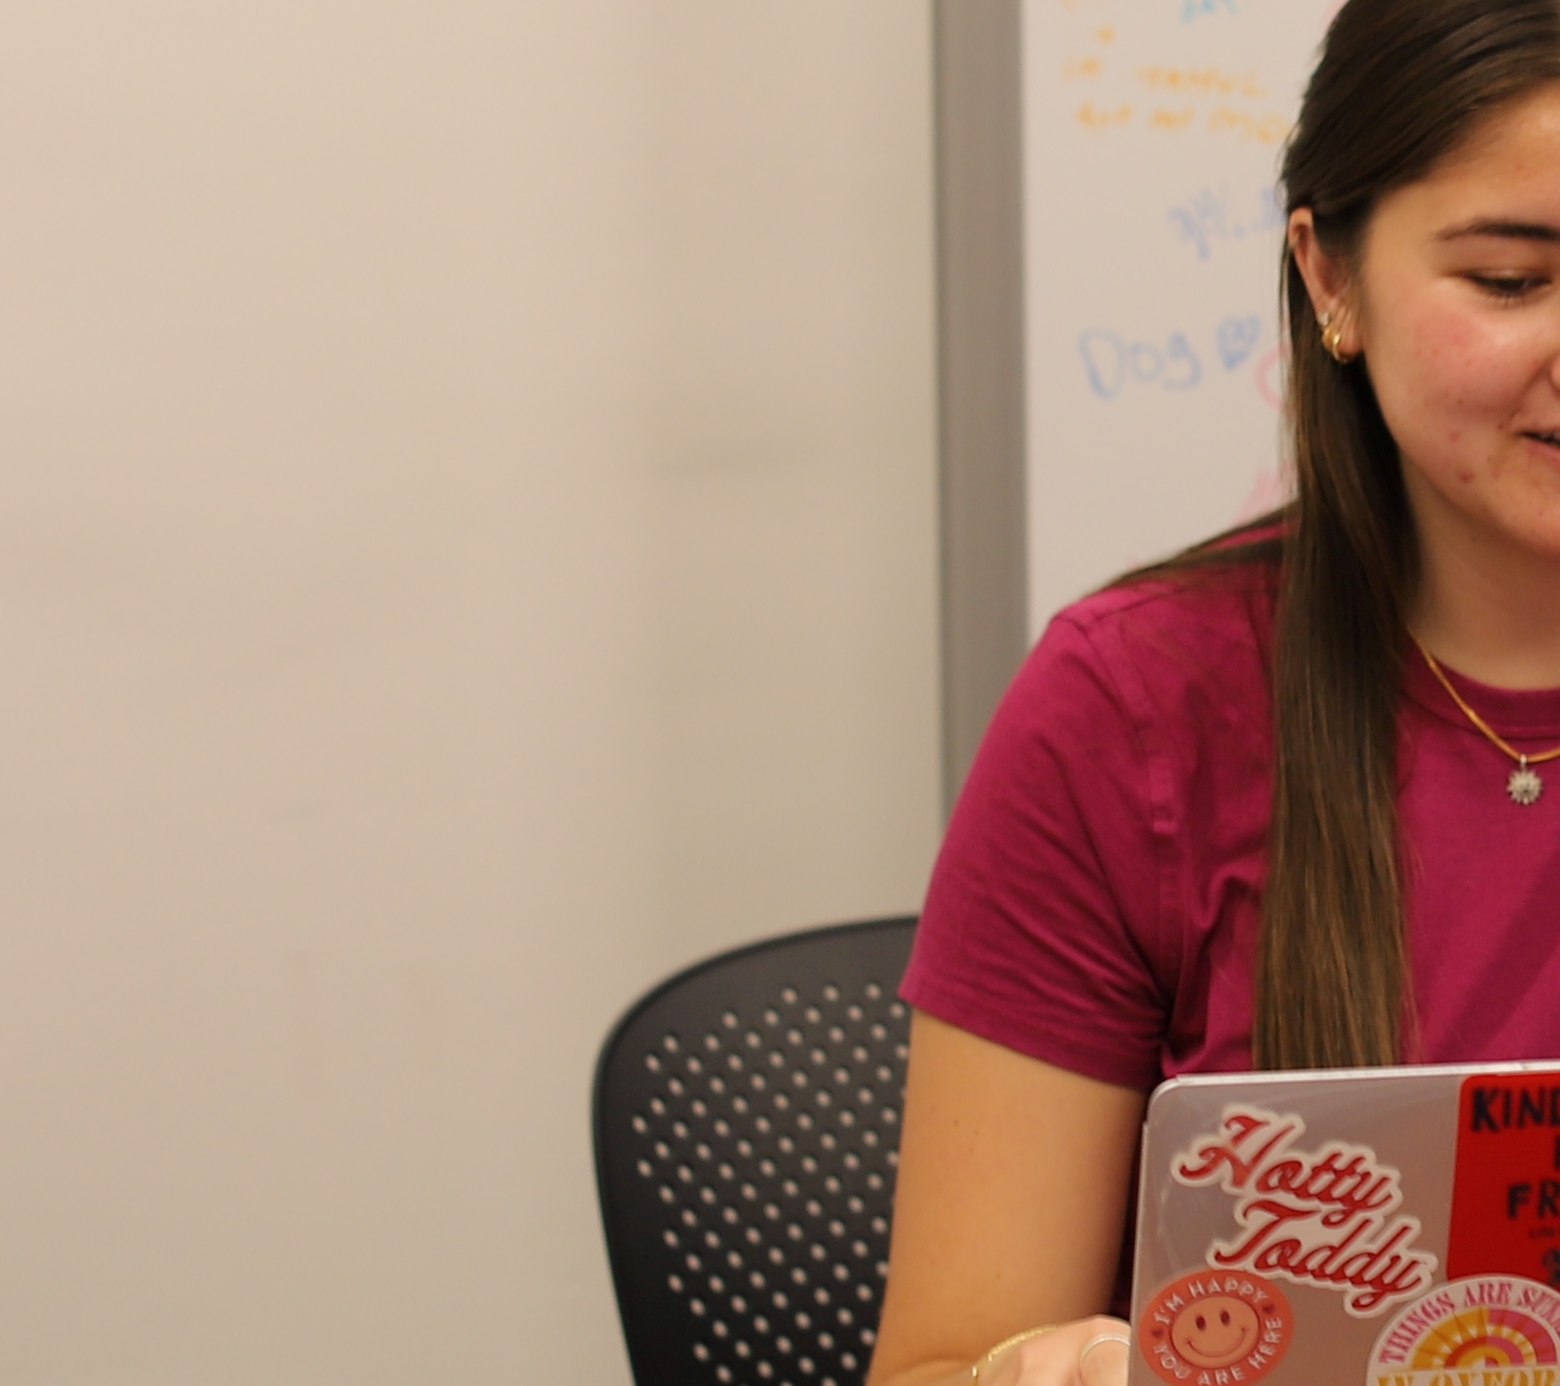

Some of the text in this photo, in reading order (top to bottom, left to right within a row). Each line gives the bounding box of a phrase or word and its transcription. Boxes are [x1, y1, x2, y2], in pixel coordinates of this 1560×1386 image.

[1077, 325, 1204, 403] Dog
[1178, 1114, 1395, 1230] Hotty
[1212, 1198, 1425, 1311] Toddy
[1153, 1275, 1270, 1327] I'M HAPPY
[1378, 1290, 1457, 1364] THINGS
[1462, 1281, 1514, 1308] ARE
[1152, 1315, 1284, 1386] YOU ARE HERE
